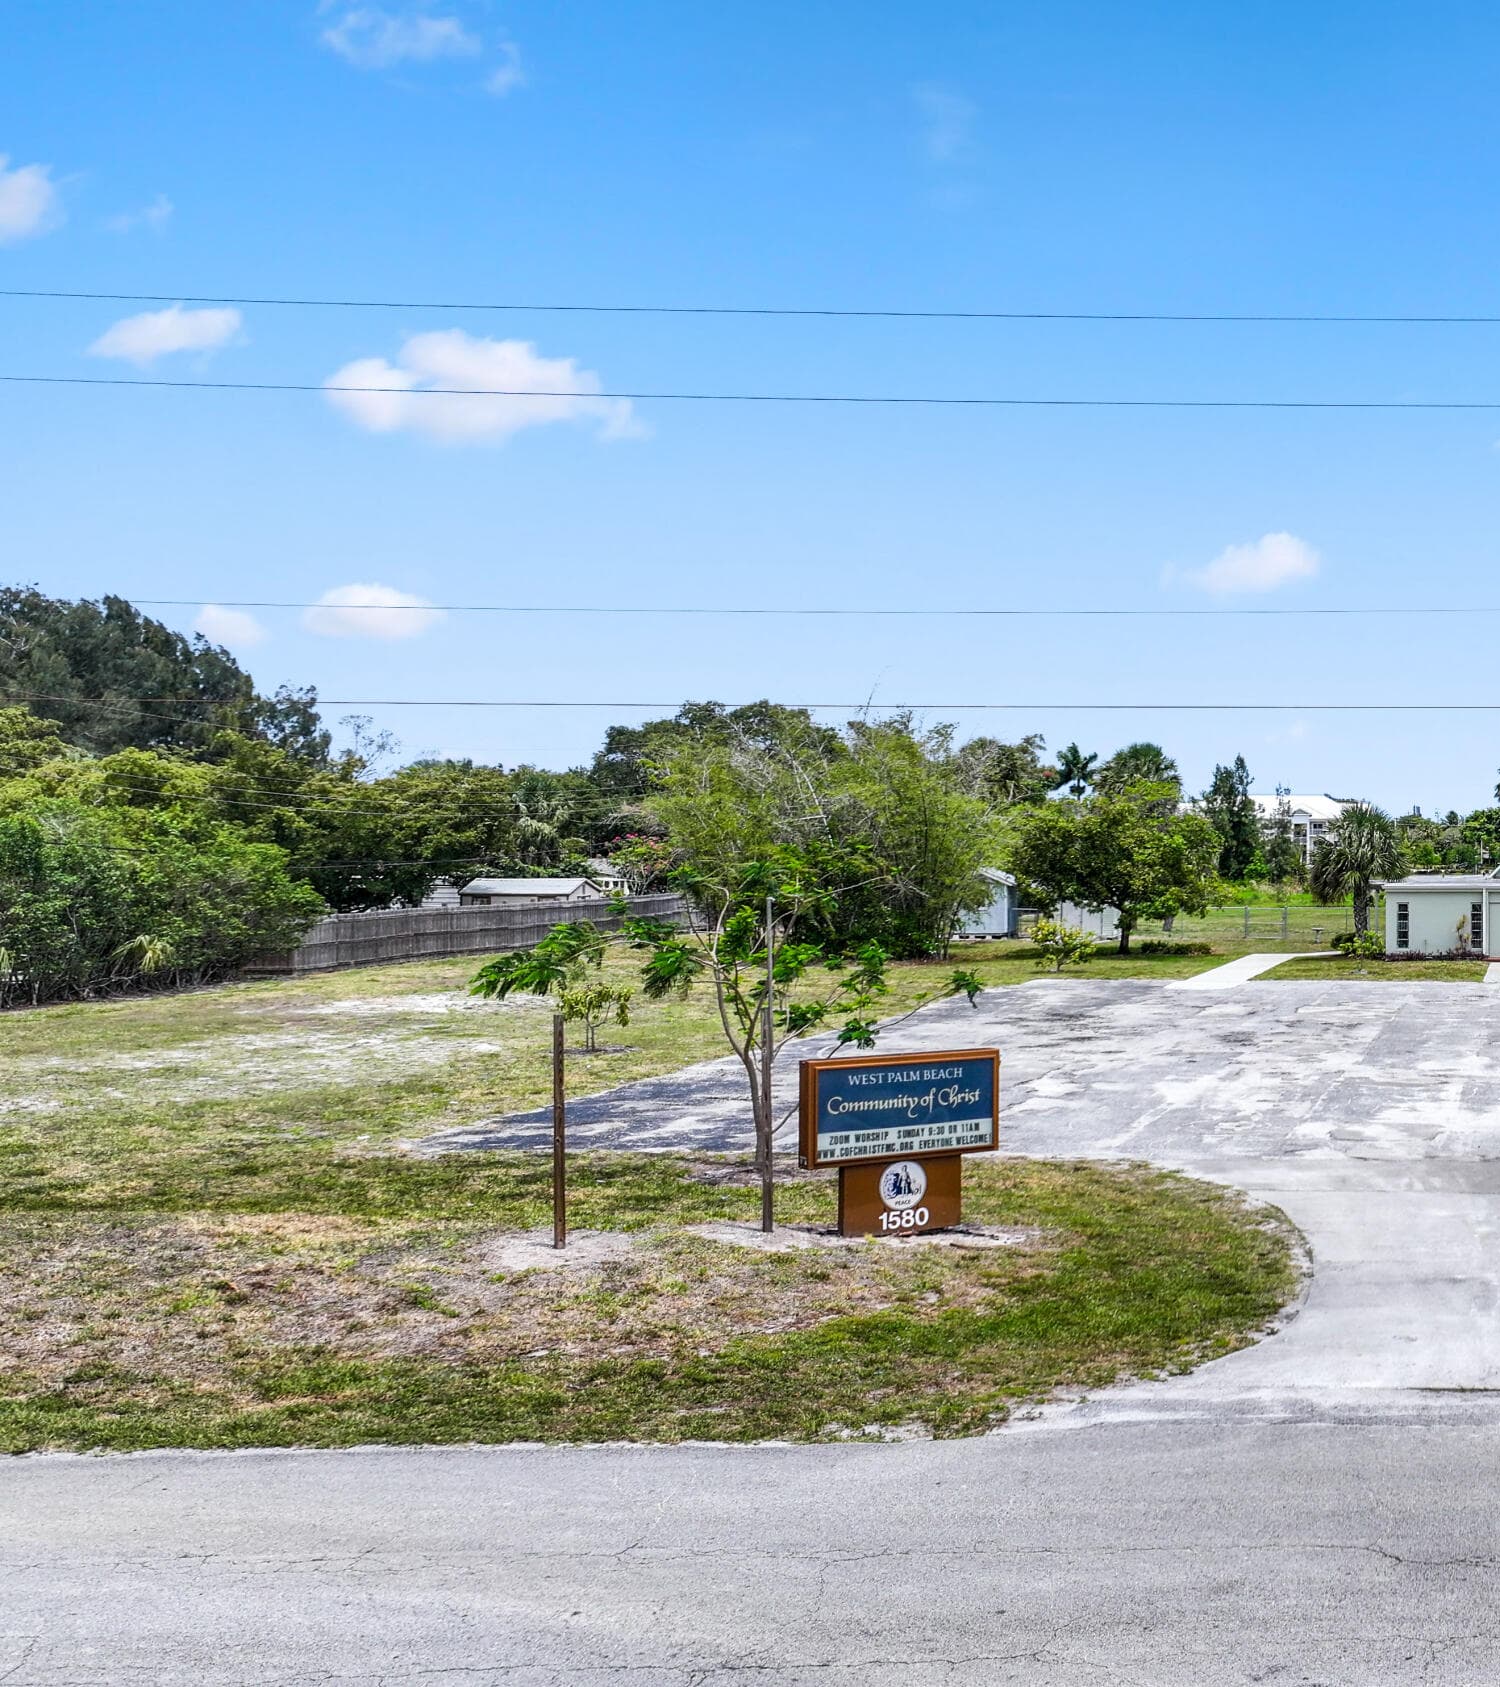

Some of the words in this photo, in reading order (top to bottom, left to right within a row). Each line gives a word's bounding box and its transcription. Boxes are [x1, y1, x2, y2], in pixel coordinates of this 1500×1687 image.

[848, 1073, 885, 1085] WEST
[887, 1071, 920, 1083] PALM
[923, 1067, 963, 1081] BEACH
[827, 1094, 918, 1118] Community
[920, 1087, 937, 1113] of
[938, 1084, 981, 1108] Christ
[829, 1134, 850, 1145] ZOOM
[854, 1131, 889, 1143] WORSHIP
[897, 1127, 925, 1139] SUNDAY
[948, 1124, 957, 1134] OR
[919, 1137, 953, 1149] EVERYONE
[878, 1206, 929, 1231] 1580
